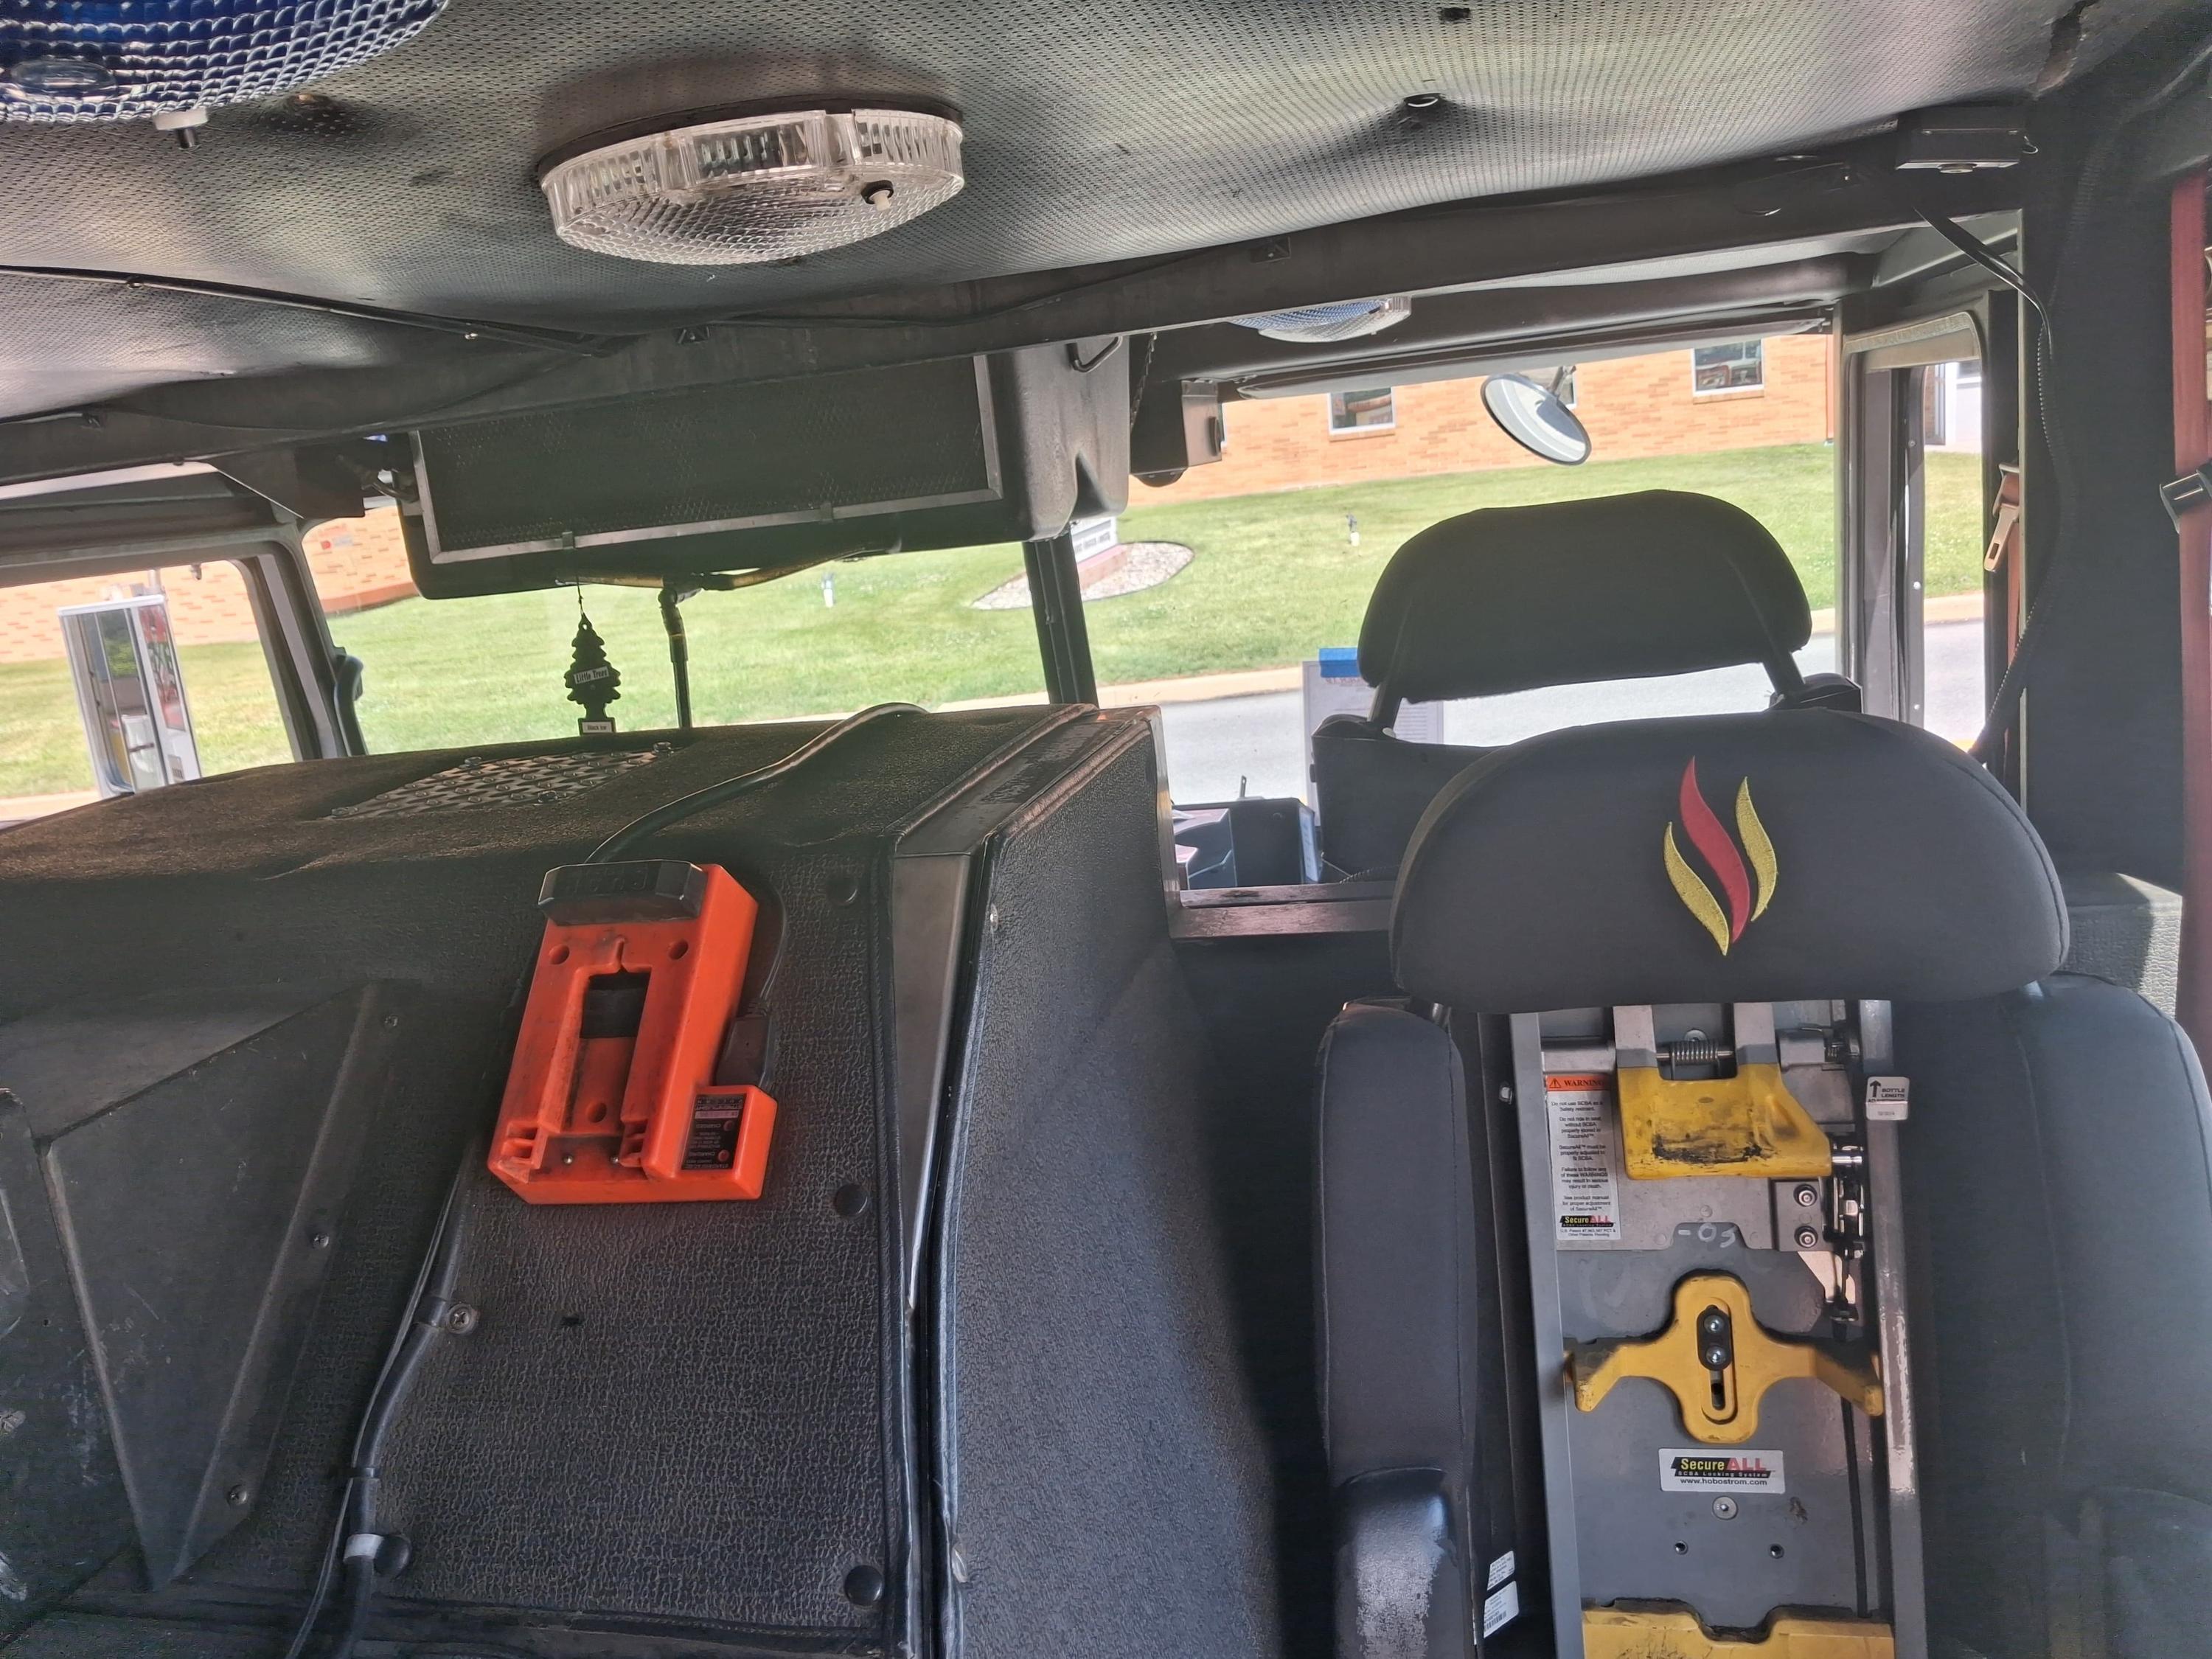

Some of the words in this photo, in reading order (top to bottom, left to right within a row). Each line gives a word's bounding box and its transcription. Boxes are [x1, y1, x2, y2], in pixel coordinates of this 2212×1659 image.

[576, 672, 591, 683] Little
[592, 669, 608, 678] Trees
[1680, 1478, 1767, 1486] www.hobostrom.com
